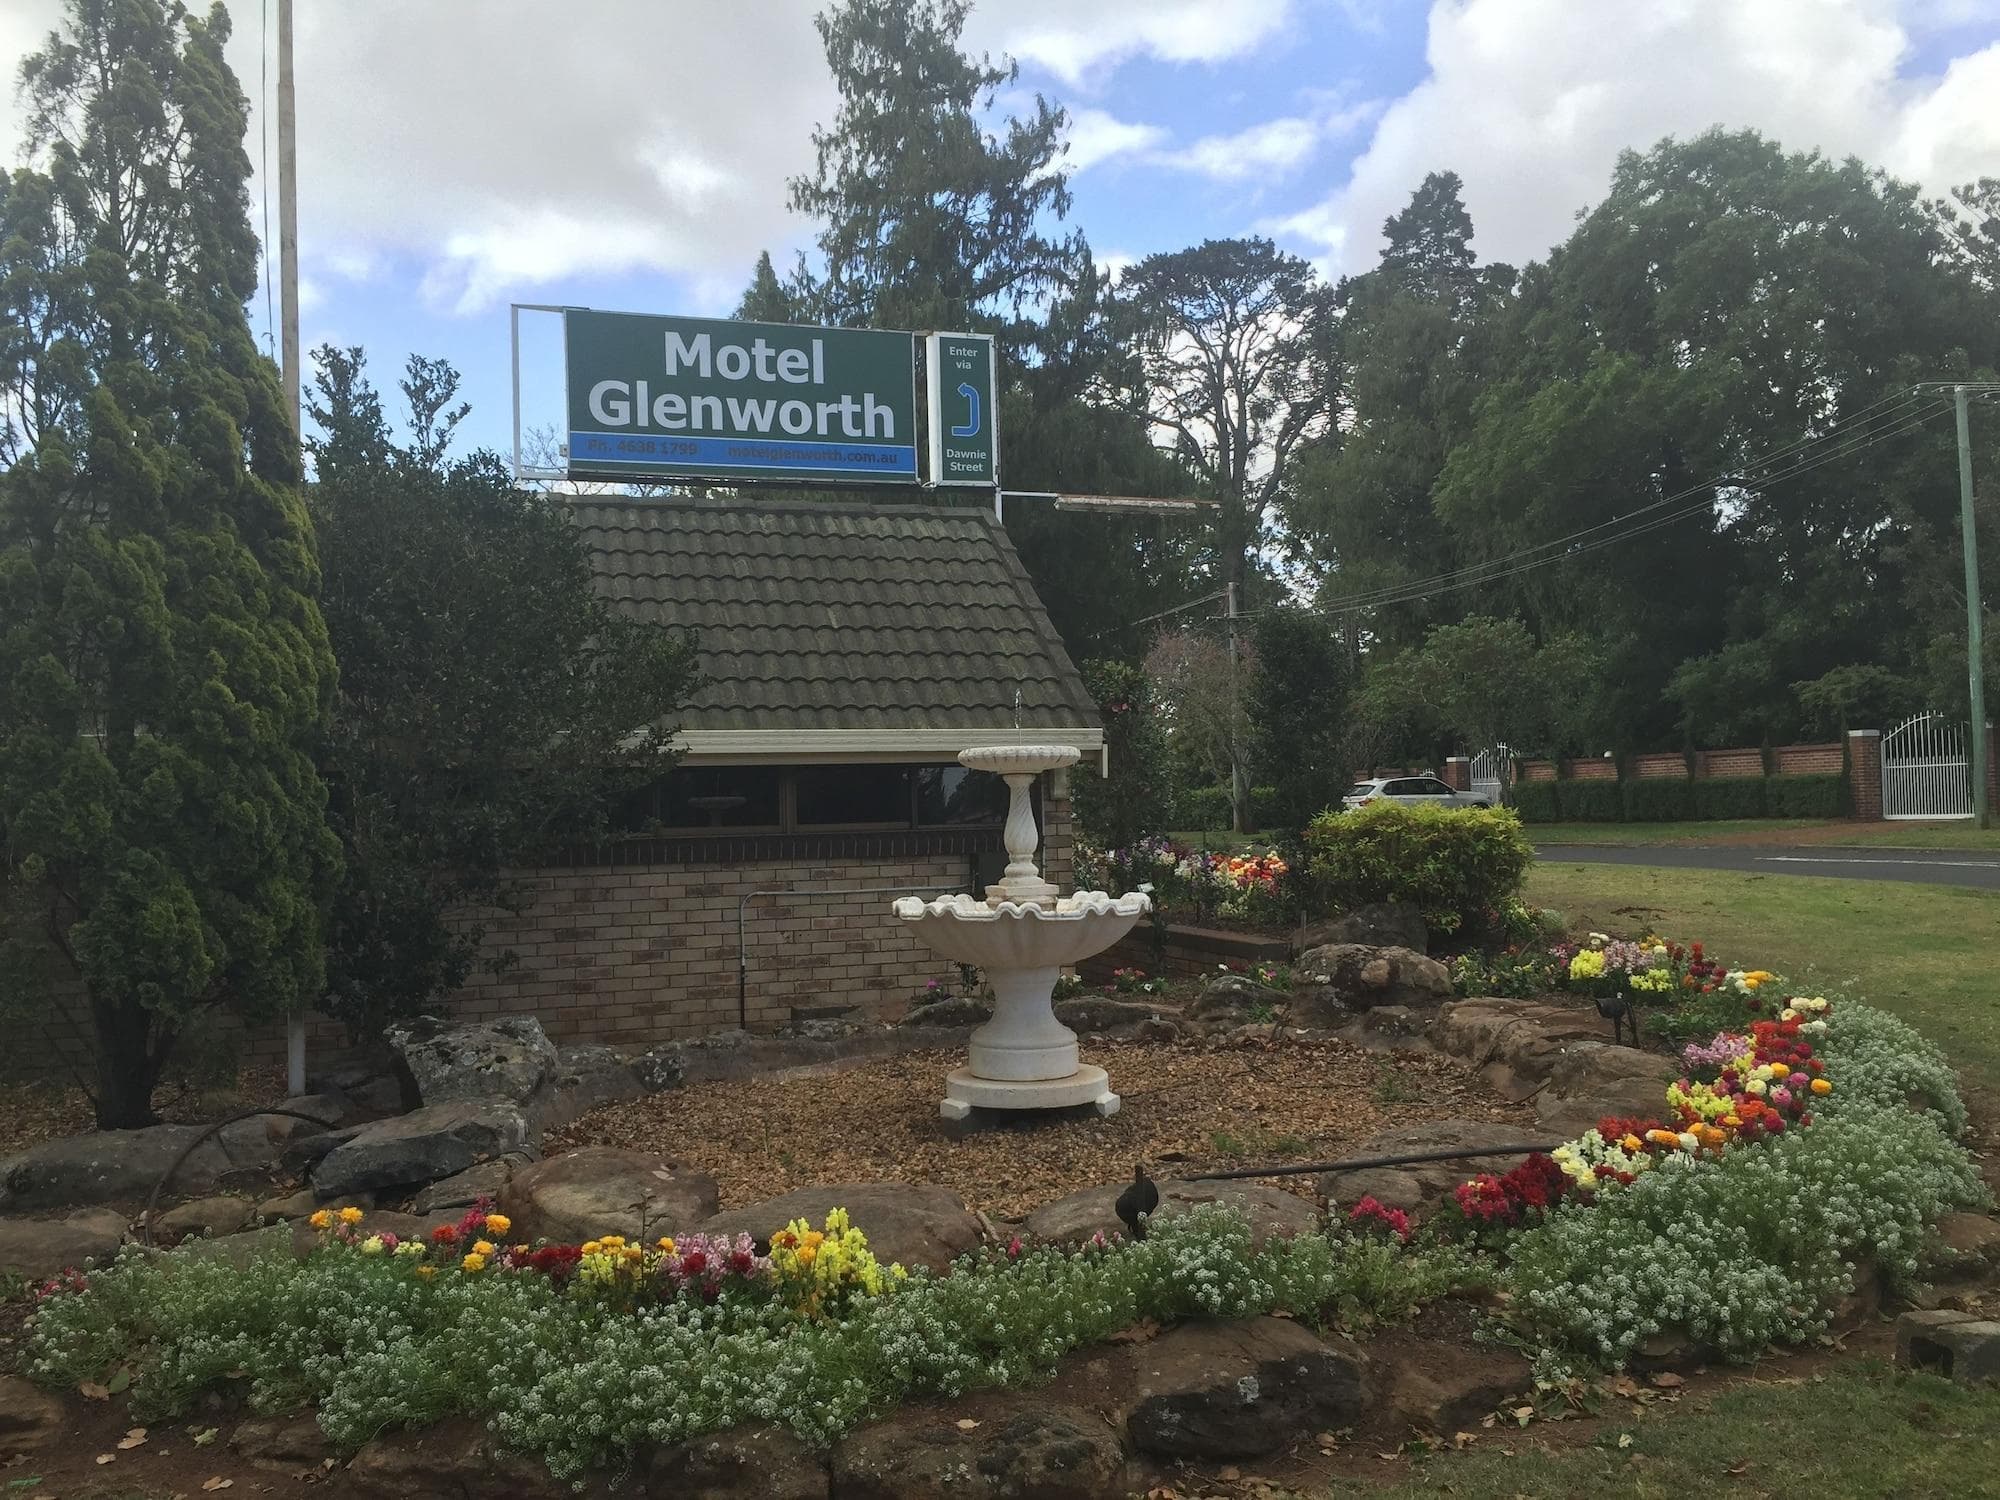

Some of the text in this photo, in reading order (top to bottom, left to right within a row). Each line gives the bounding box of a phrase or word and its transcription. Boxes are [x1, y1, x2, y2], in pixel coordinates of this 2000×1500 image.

[949, 346, 978, 357] Enter
[664, 331, 825, 385] Motel
[955, 360, 972, 369] via
[588, 379, 896, 439] Glenworth
[946, 449, 987, 459] Dawnie
[949, 461, 984, 472] Street
